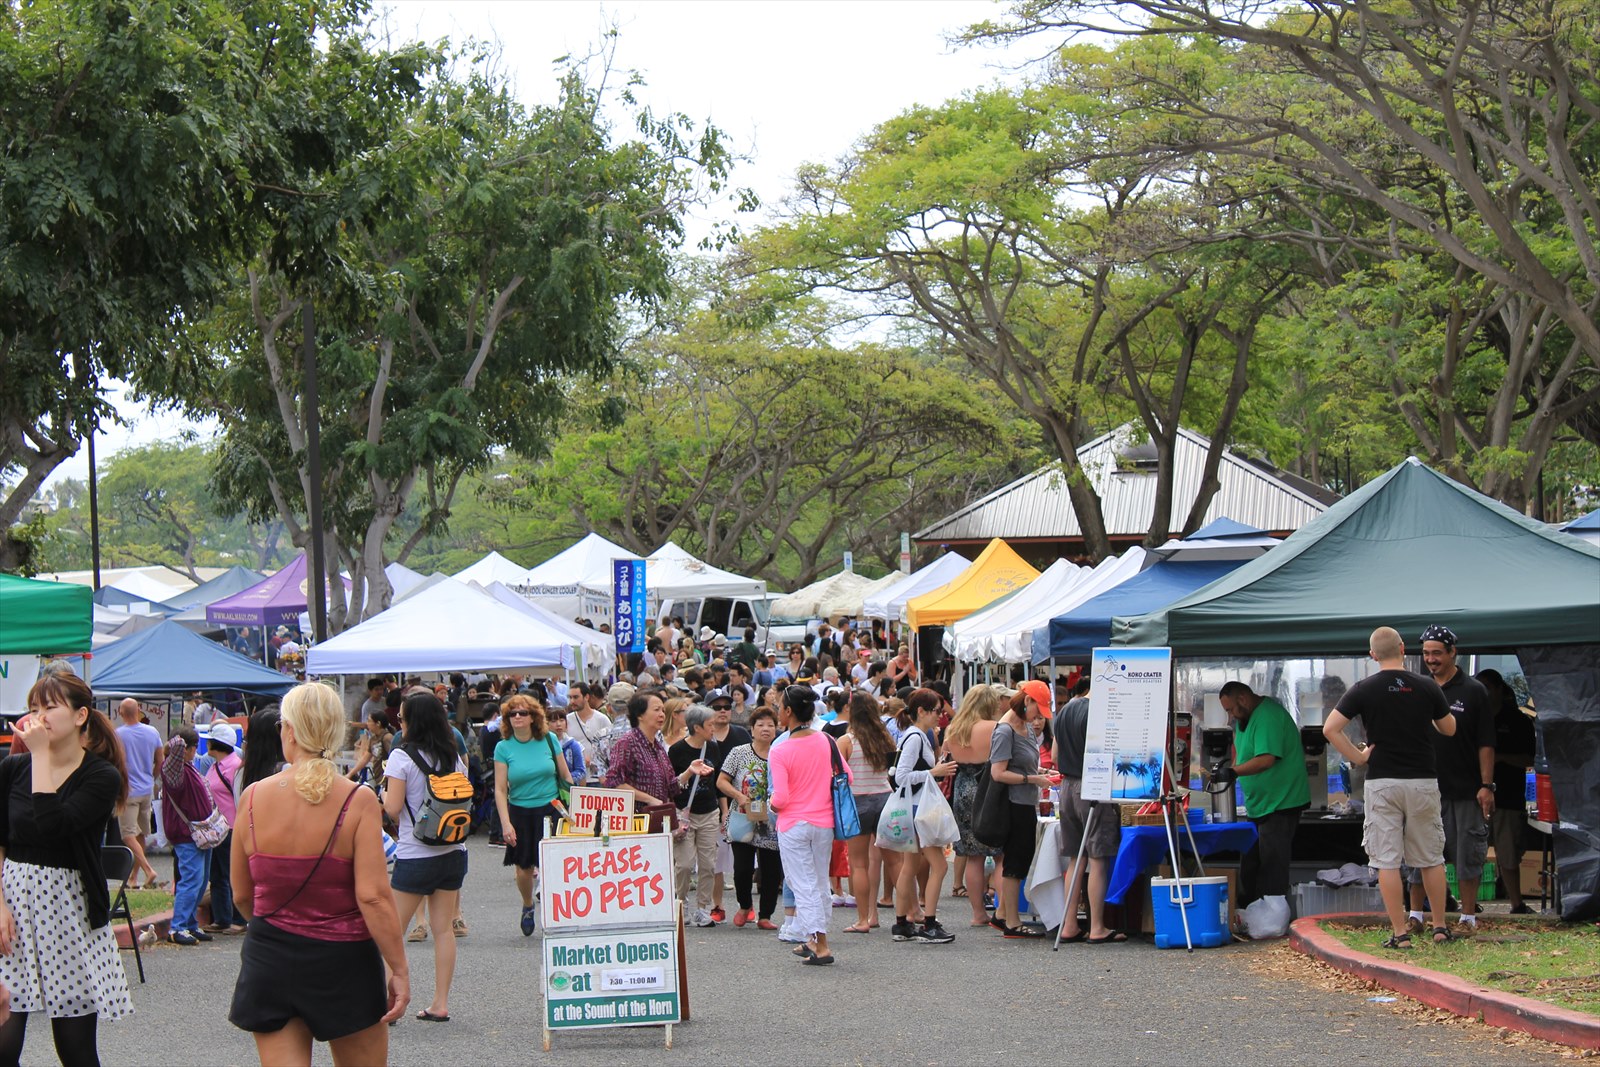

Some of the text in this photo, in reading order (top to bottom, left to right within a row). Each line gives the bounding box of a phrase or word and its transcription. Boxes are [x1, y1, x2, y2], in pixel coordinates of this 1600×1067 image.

[559, 586, 577, 595] COOLER
[617, 600, 633, 647] あわび
[580, 795, 625, 812] TODAY'S
[574, 813, 593, 828] TIP
[563, 844, 651, 883] PLEASE,
[552, 873, 664, 922] NO PETS
[552, 942, 670, 967] Market Opens
[571, 972, 592, 992] at
[629, 977, 646, 985] 11:00
[646, 976, 657, 984] AM
[553, 998, 673, 1021] at the Sound of the Horn
